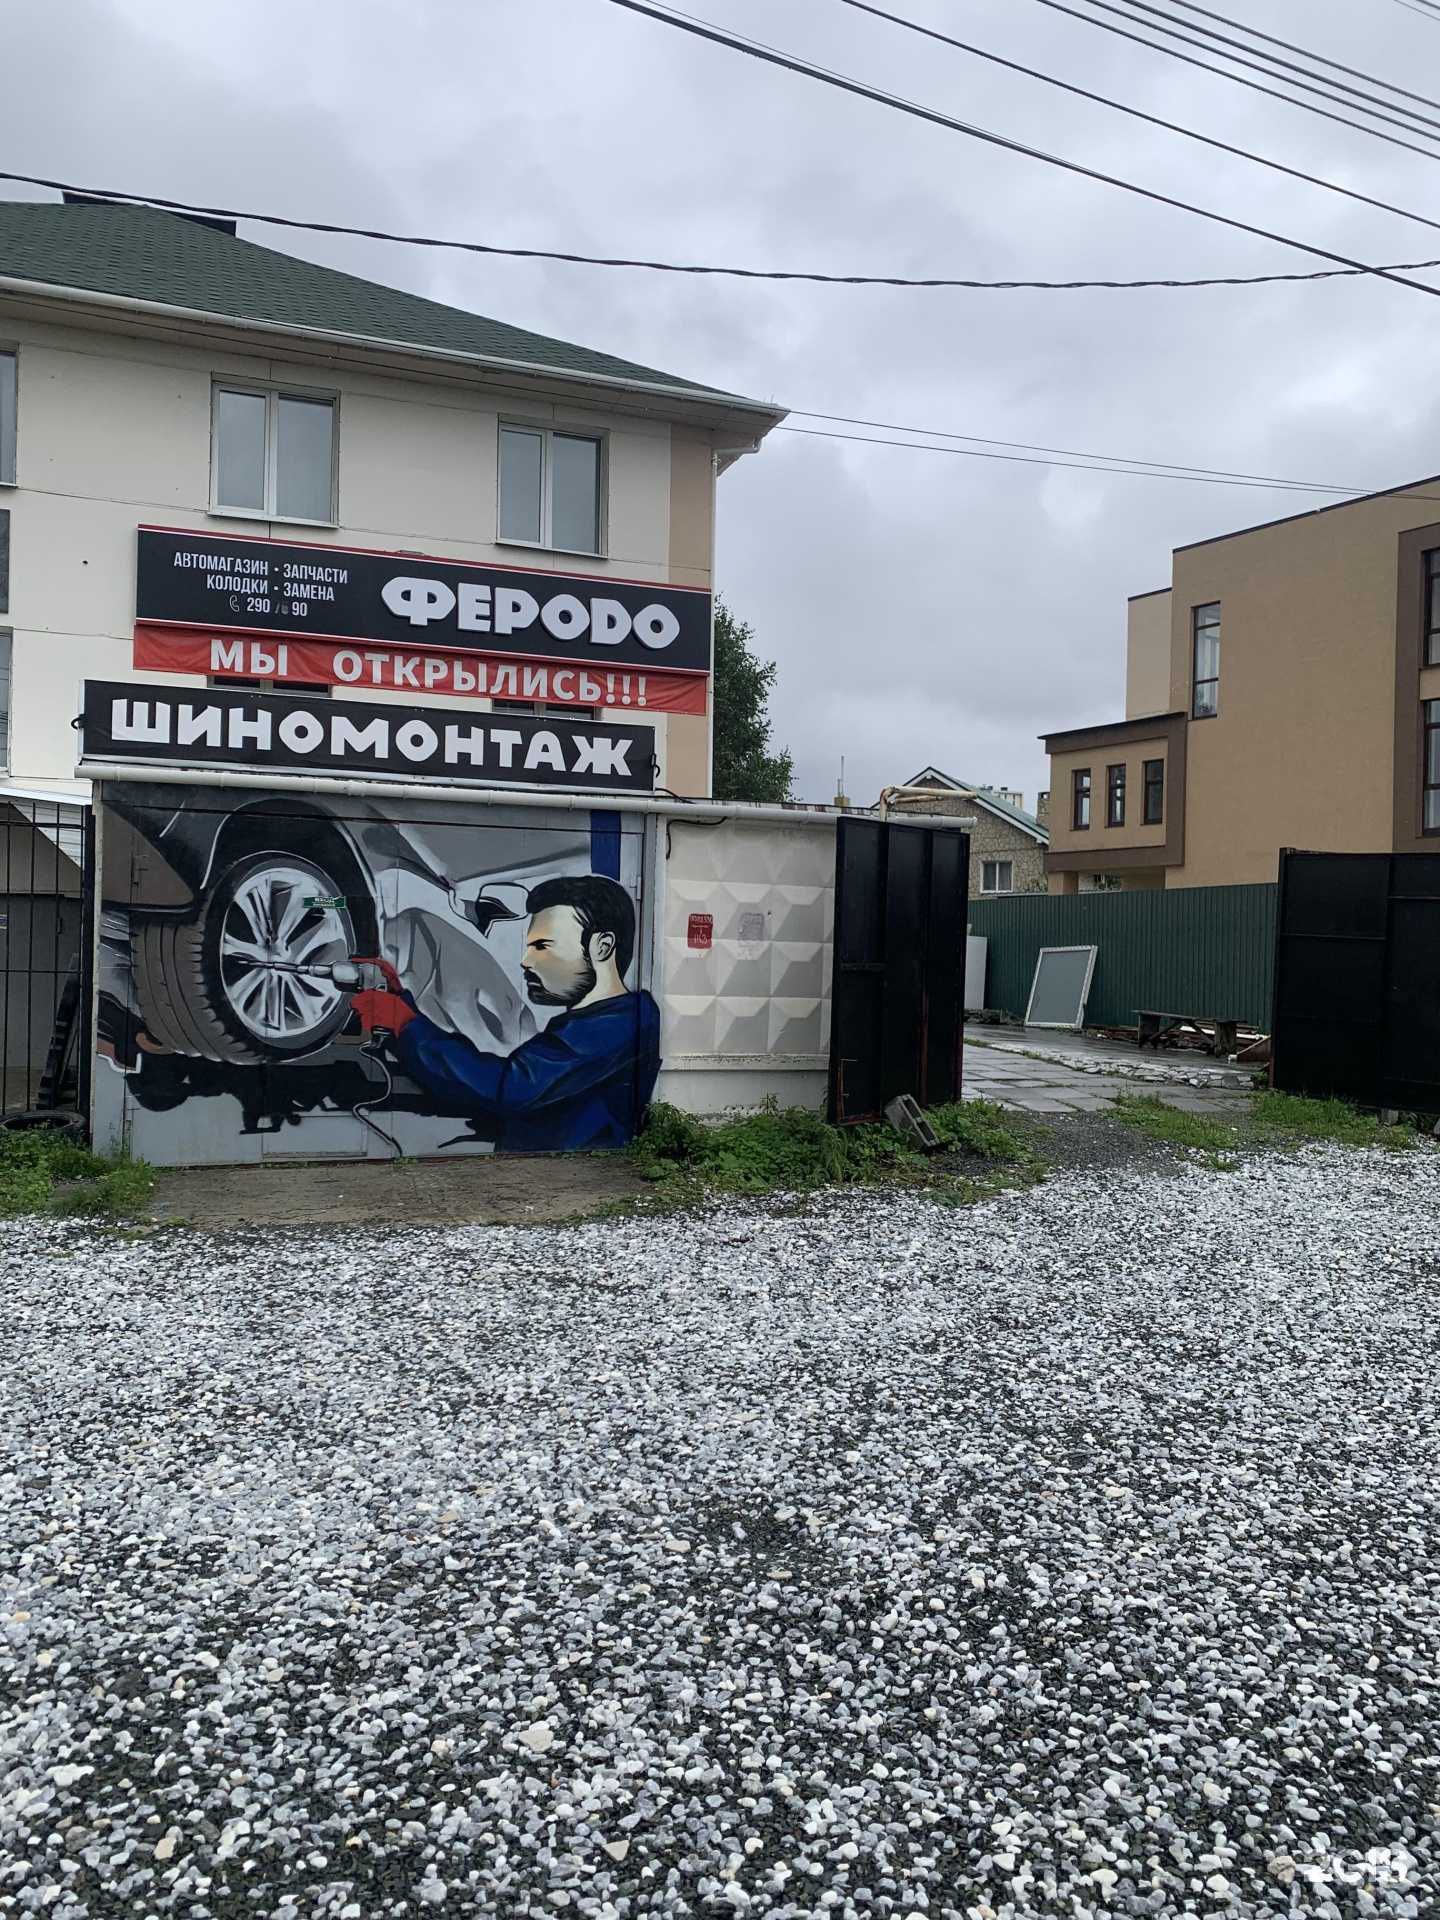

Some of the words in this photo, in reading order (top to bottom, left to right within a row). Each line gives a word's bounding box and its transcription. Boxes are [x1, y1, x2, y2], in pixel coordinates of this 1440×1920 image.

[173, 551, 269, 576] АВТОМАГАЗИН
[283, 563, 349, 584] ЗАПЧАСТИ
[206, 574, 268, 594] КОЛОДКИ
[283, 582, 335, 601] ЗАМЕНА
[246, 597, 271, 614] 290
[291, 601, 308, 617] 90
[210, 639, 288, 676] МЫ
[332, 649, 648, 706] ОТКРЫЛИСЬ!!!
[111, 698, 634, 777] ШИНОМОНТАЖ
